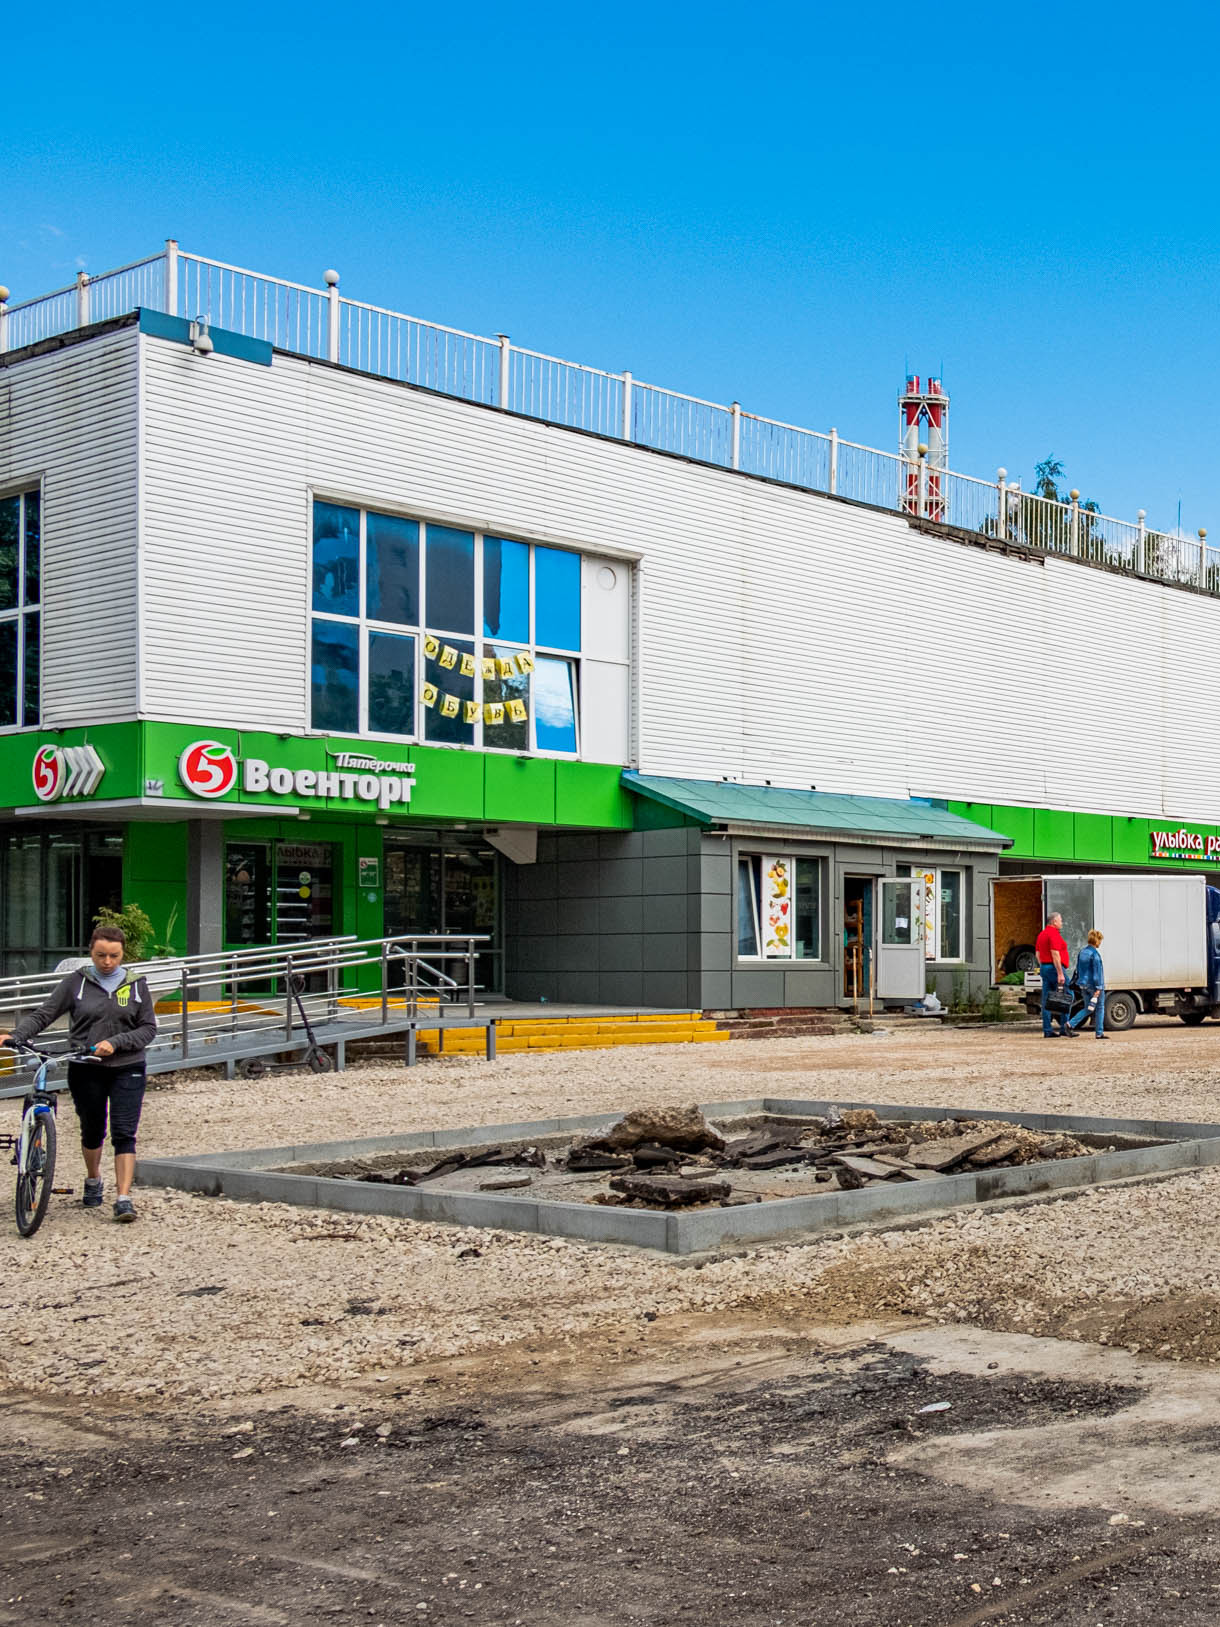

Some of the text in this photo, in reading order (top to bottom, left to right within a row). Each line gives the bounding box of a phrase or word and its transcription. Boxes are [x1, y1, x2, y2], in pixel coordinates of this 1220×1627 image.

[425, 641, 532, 676] ОДЕЖДА
[423, 689, 523, 719] ОБУВЬ
[244, 759, 417, 809] Военторг
[1151, 829, 1204, 852] улыбка
